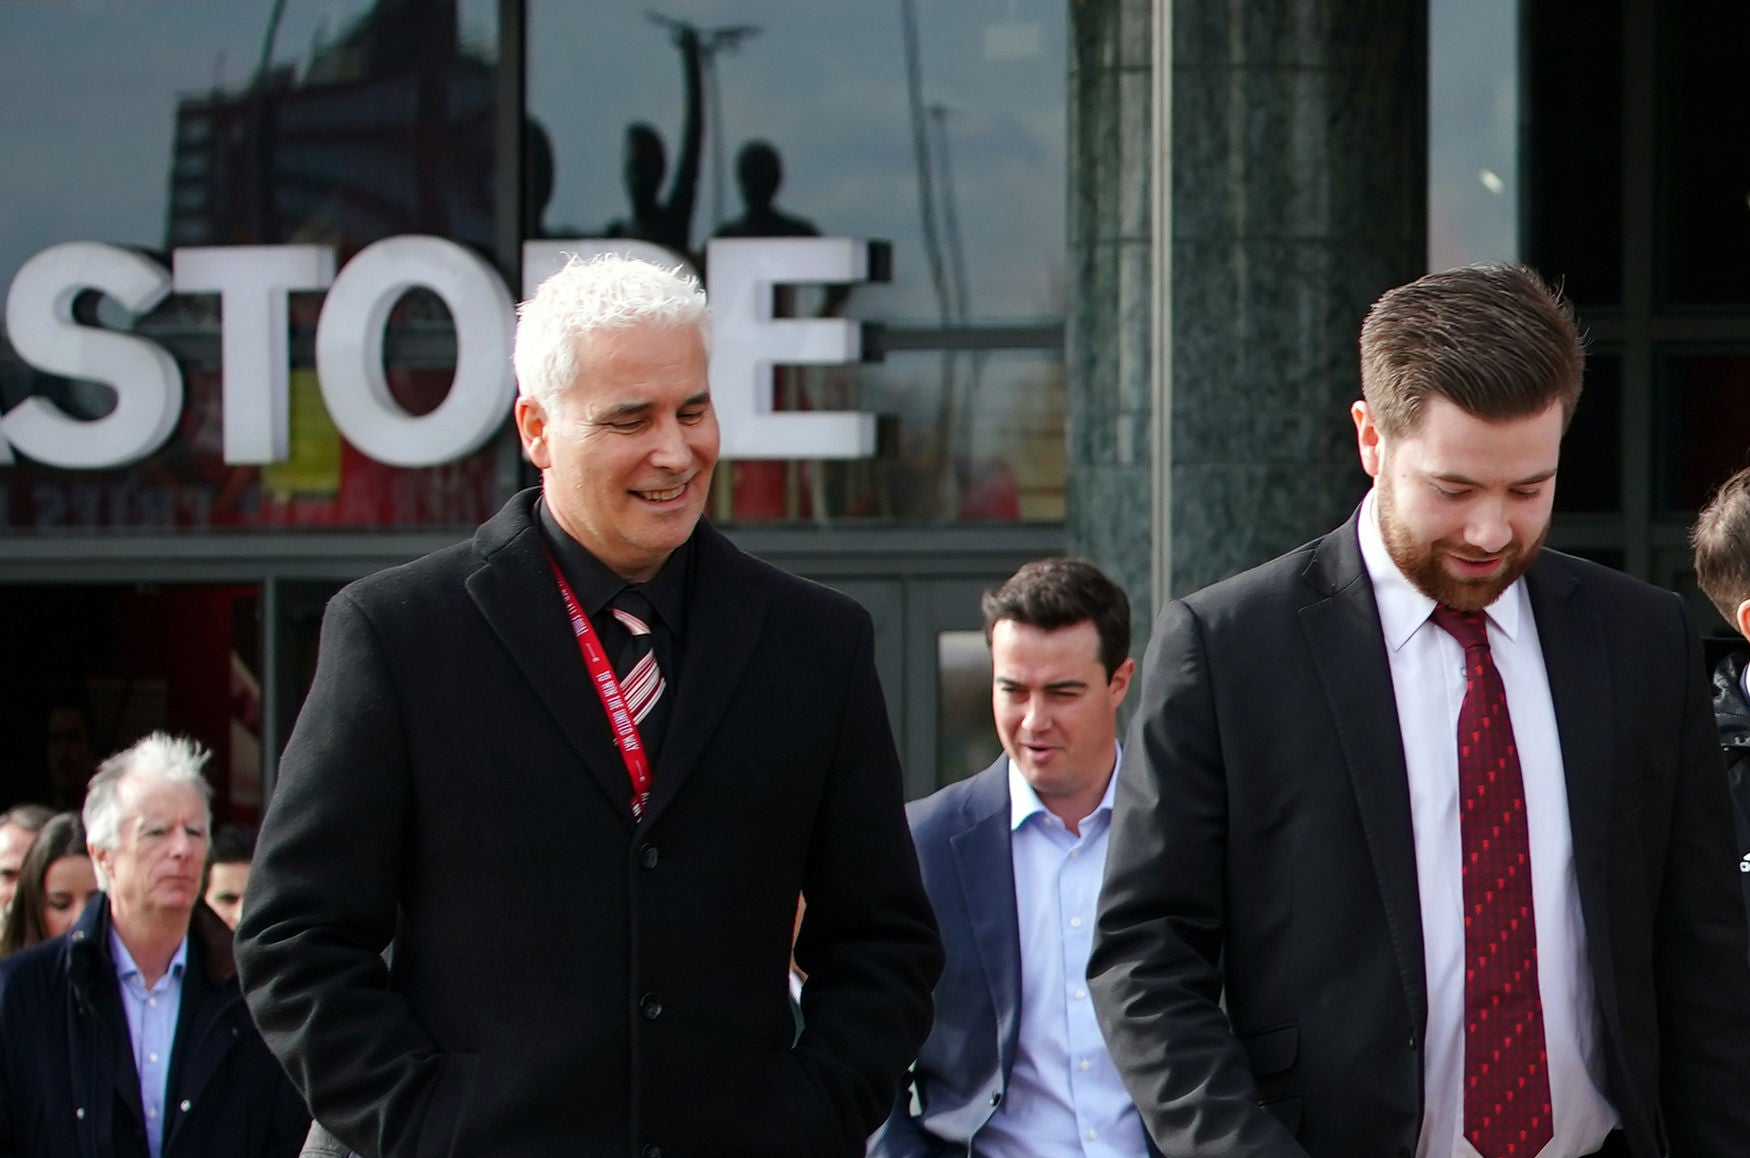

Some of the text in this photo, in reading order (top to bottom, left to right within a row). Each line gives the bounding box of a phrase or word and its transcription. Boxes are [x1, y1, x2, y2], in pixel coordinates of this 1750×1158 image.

[0, 235, 876, 469] STOE
[601, 680, 618, 697] WIN
[606, 695, 625, 711] THE
[612, 708, 634, 736] UNITED
[623, 734, 640, 752] WAY
